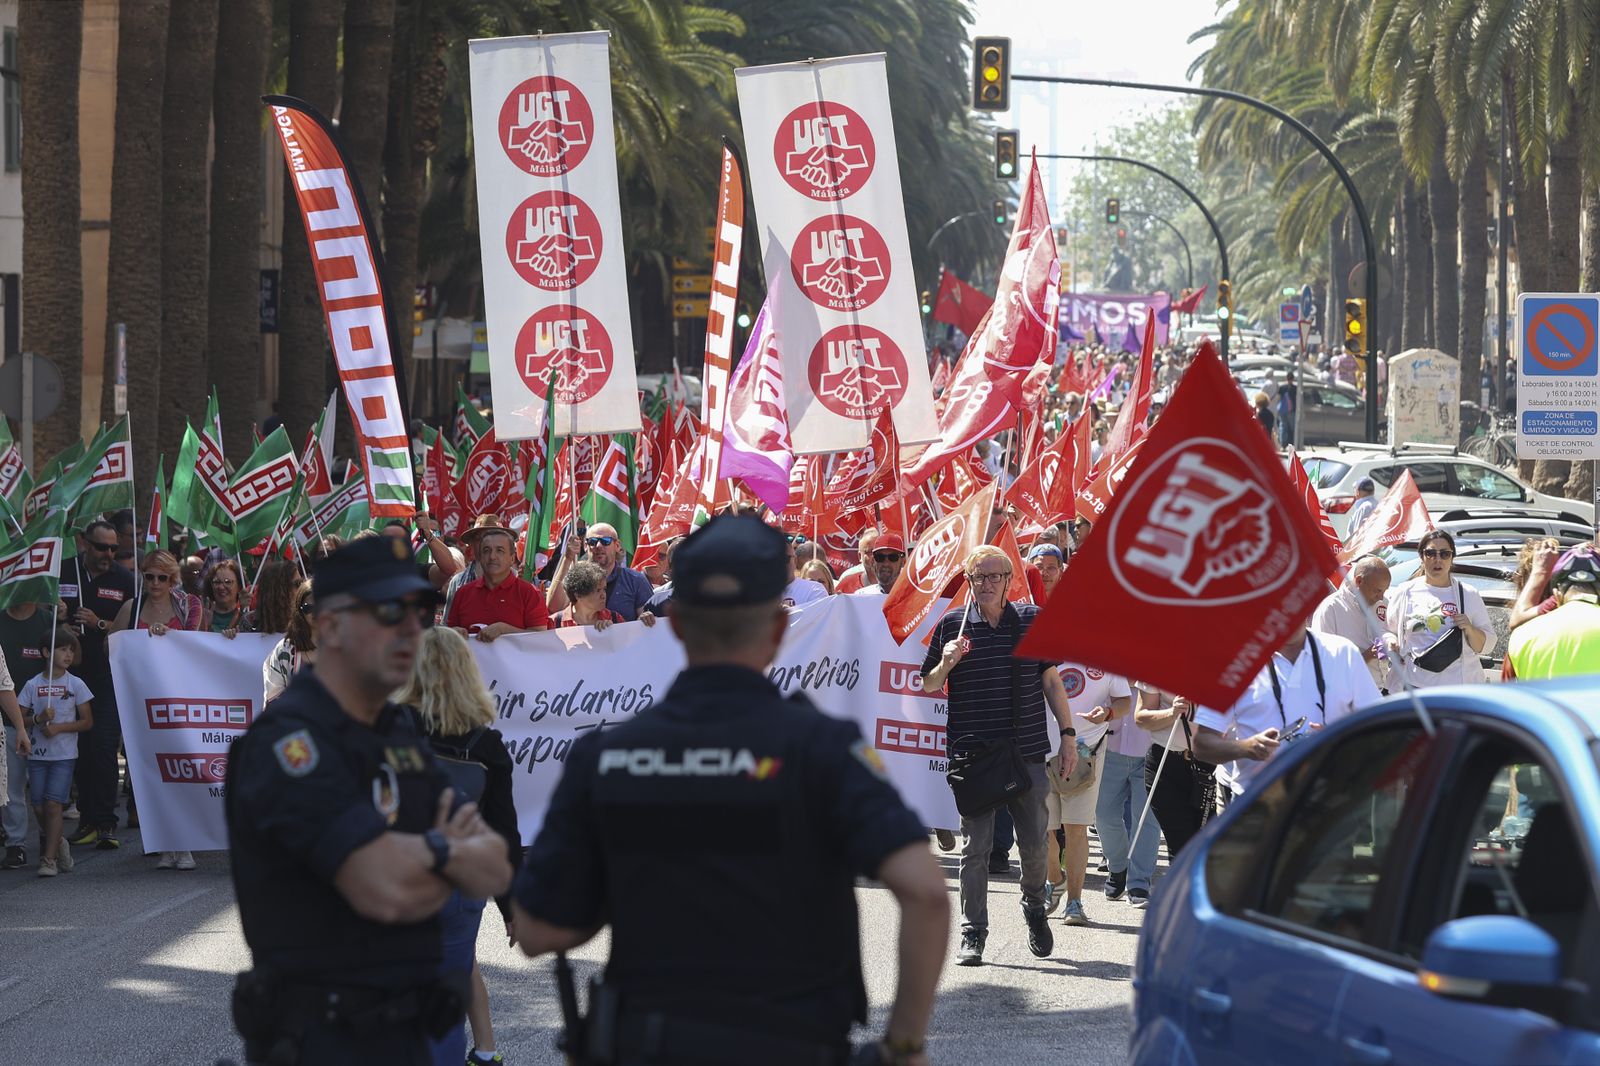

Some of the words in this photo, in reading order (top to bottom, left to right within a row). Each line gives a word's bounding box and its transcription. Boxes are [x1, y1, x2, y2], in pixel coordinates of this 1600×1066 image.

[518, 90, 571, 125] UGT
[792, 114, 850, 148] UGT
[529, 162, 568, 175] Málaga
[810, 185, 850, 199] Málaga
[525, 204, 579, 241] UGT
[810, 227, 867, 263] UGT
[538, 276, 577, 289] Málaga
[827, 297, 867, 310] Málaga
[534, 318, 590, 355] UGT
[827, 337, 882, 374] UGT
[1522, 380, 1553, 388] Laborables
[844, 405, 884, 419] Málaga
[1527, 419, 1593, 427] ESTACIONAMIENTO
[468, 454, 501, 503] UGT
[1124, 451, 1244, 579] UGT
[890, 667, 923, 691] UG
[529, 678, 654, 723] salarios
[165, 758, 207, 779] UGT
[599, 748, 757, 776] POLICIA
